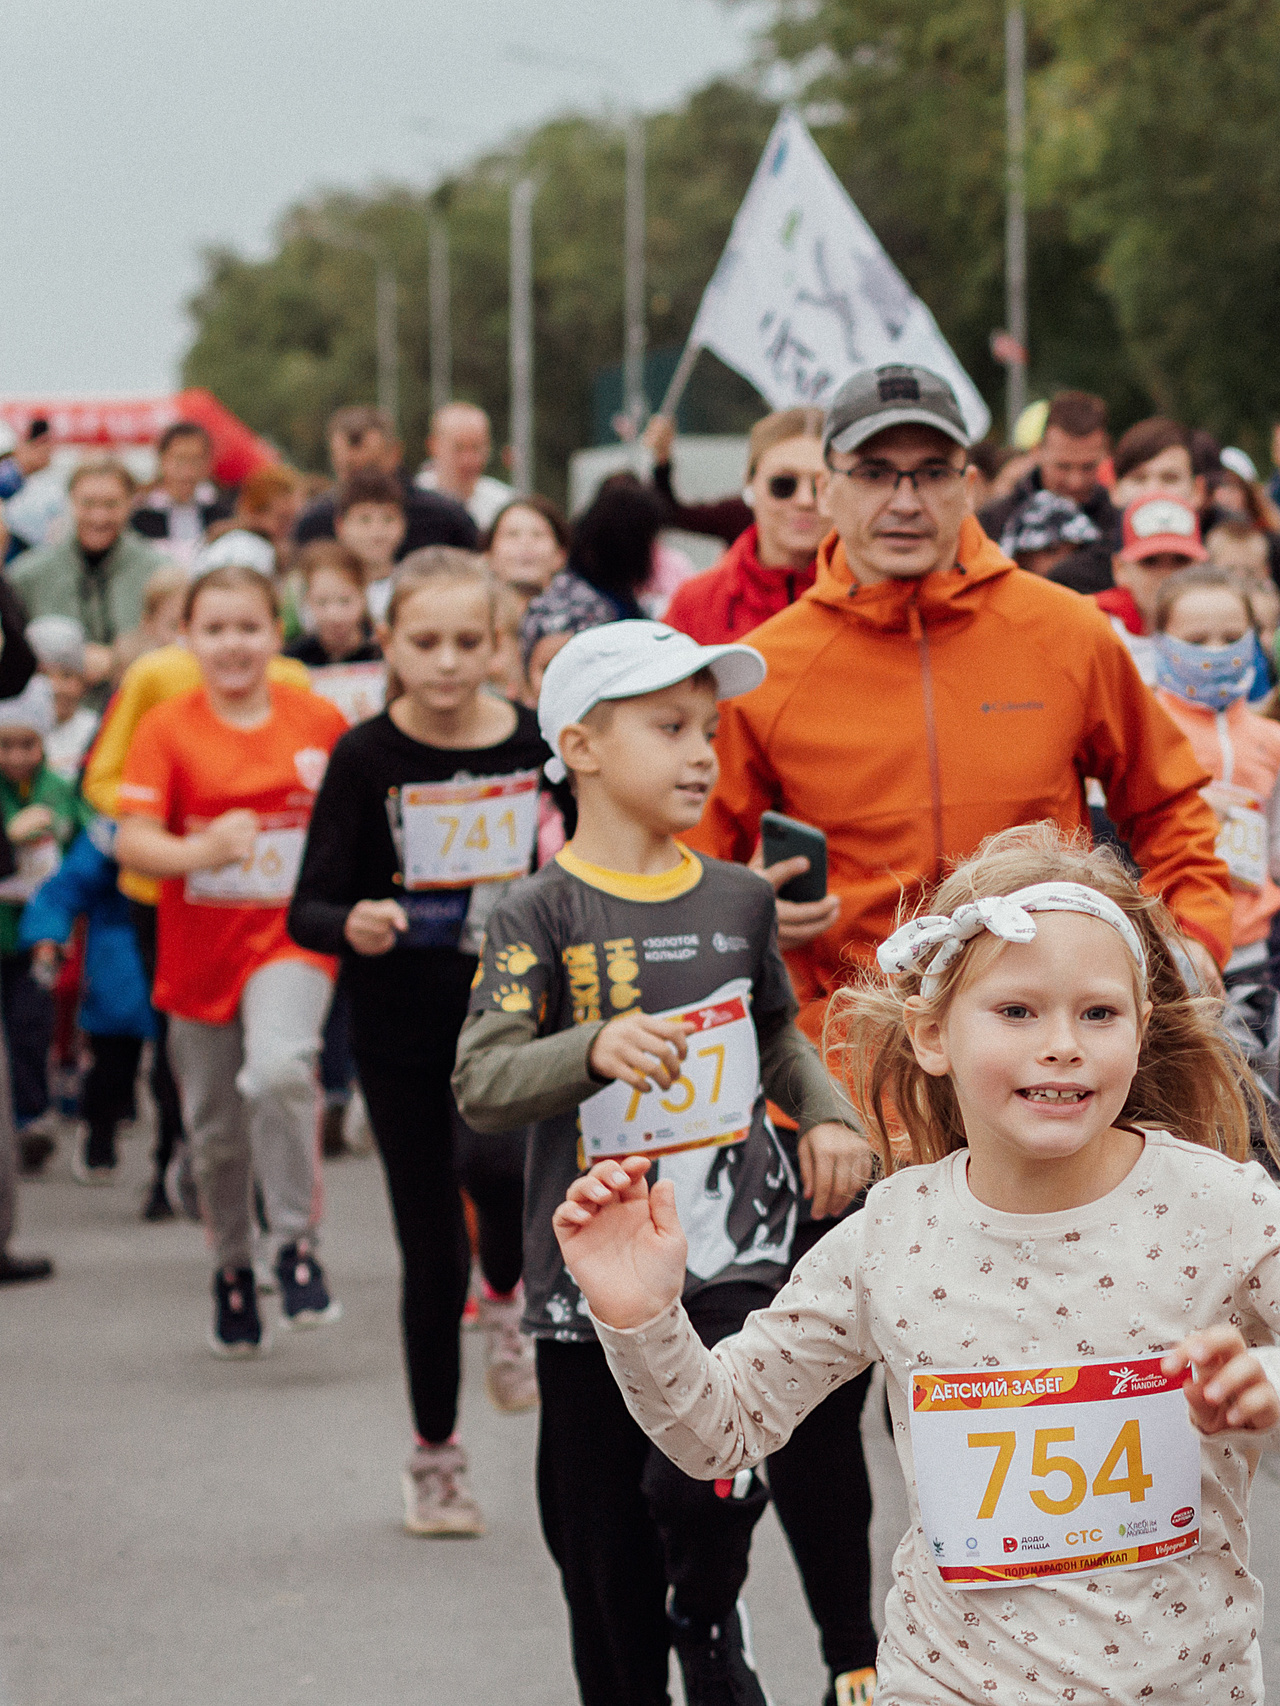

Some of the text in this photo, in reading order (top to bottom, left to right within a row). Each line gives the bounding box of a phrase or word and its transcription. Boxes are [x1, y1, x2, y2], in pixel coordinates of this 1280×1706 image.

[435, 810, 517, 858] 741
[931, 1377, 1063, 1402] ДЕТСКИЙ ЗАБЕГ
[1131, 1378, 1168, 1391] HANDICAP
[967, 1419, 1153, 1520] 754
[1021, 1535, 1045, 1544] ДОДО
[1021, 1542, 1051, 1551] ПИЦЦА
[1065, 1529, 1103, 1546] СТС
[1004, 1552, 1128, 1577] ПОЛУМАРАФОН ГАНДИКАП
